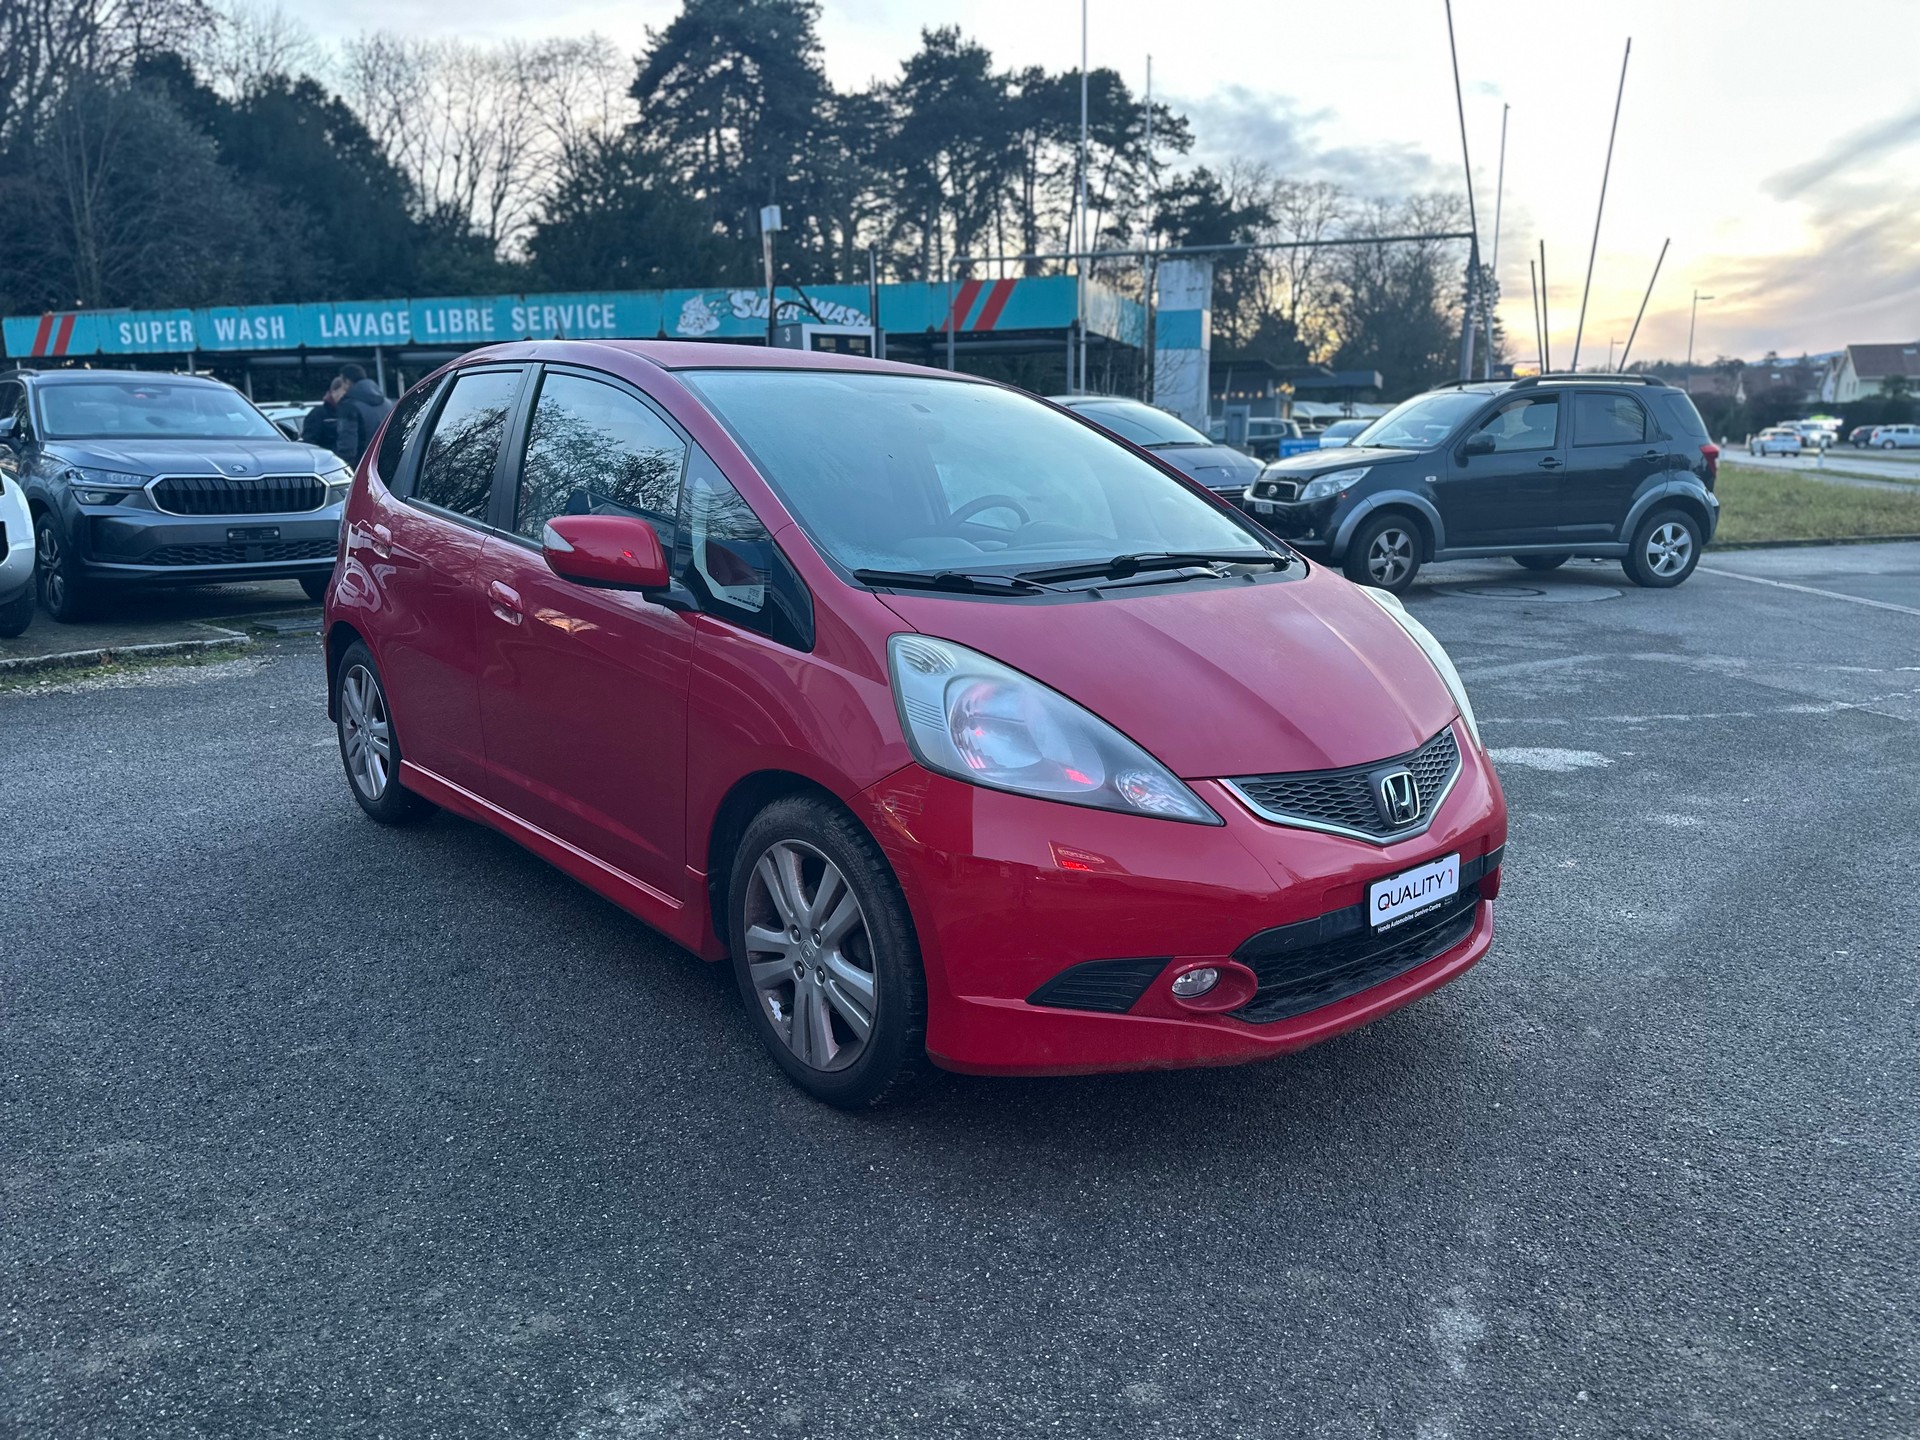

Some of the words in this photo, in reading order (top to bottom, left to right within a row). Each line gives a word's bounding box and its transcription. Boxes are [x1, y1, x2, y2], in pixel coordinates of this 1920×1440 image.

[119, 320, 194, 345] SUPER
[214, 316, 286, 342] WASH
[319, 311, 411, 338] LAVAGE
[425, 308, 494, 334] LIBRE
[511, 304, 616, 332] SERVICE
[784, 328, 791, 342] 3
[1377, 871, 1445, 911] QUALITY
[1377, 924, 1390, 934] Honda
